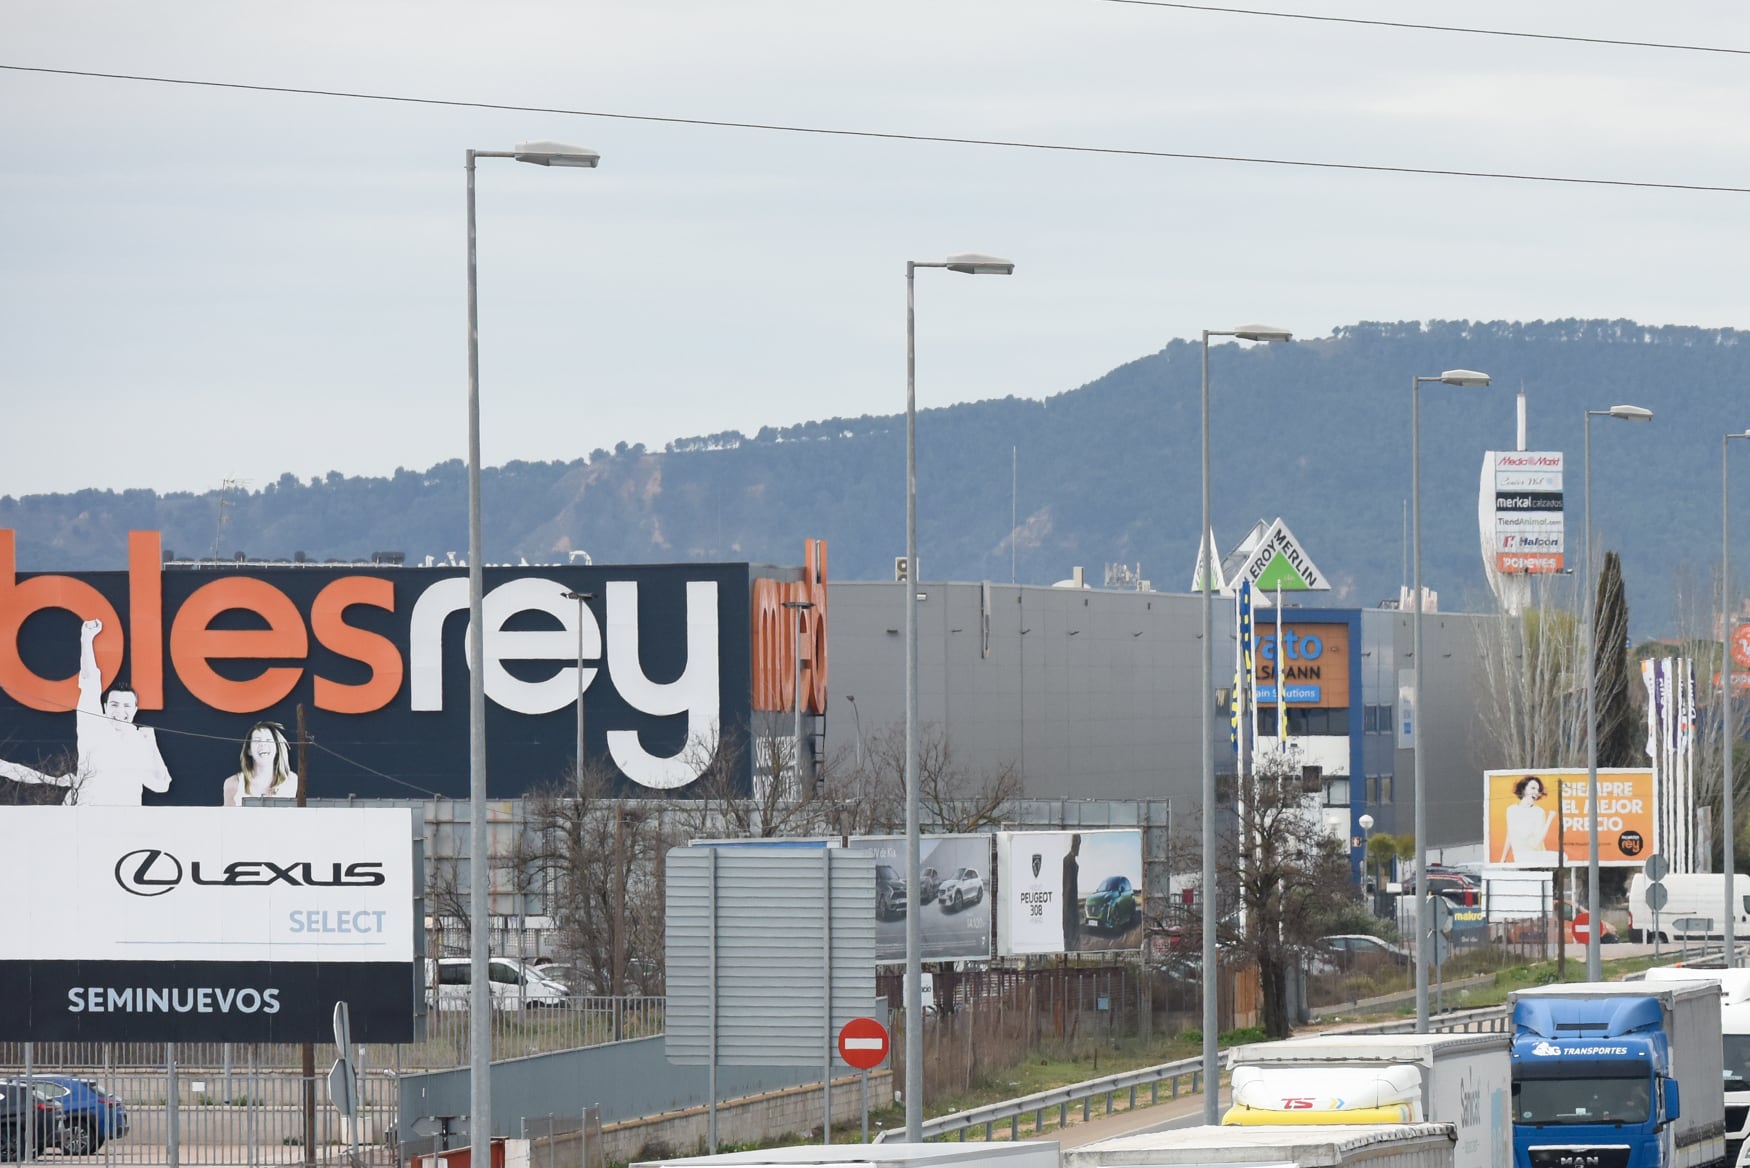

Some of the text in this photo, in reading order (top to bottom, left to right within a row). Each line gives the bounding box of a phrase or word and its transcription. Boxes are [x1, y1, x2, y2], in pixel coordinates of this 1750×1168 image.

[1497, 496, 1531, 508] merkal
[1274, 528, 1317, 587] MERLIN
[1562, 800, 1579, 814] EL
[191, 861, 386, 887] LEXUS
[1020, 891, 1053, 904] PEUGEOT
[1030, 904, 1043, 916] 308
[1454, 911, 1484, 921] makro
[288, 910, 387, 934] SELECT
[67, 987, 282, 1014] SEMINUEVOS
[1563, 1047, 1628, 1056] TRANSPORTES
[1560, 1156, 1599, 1165] MAN
